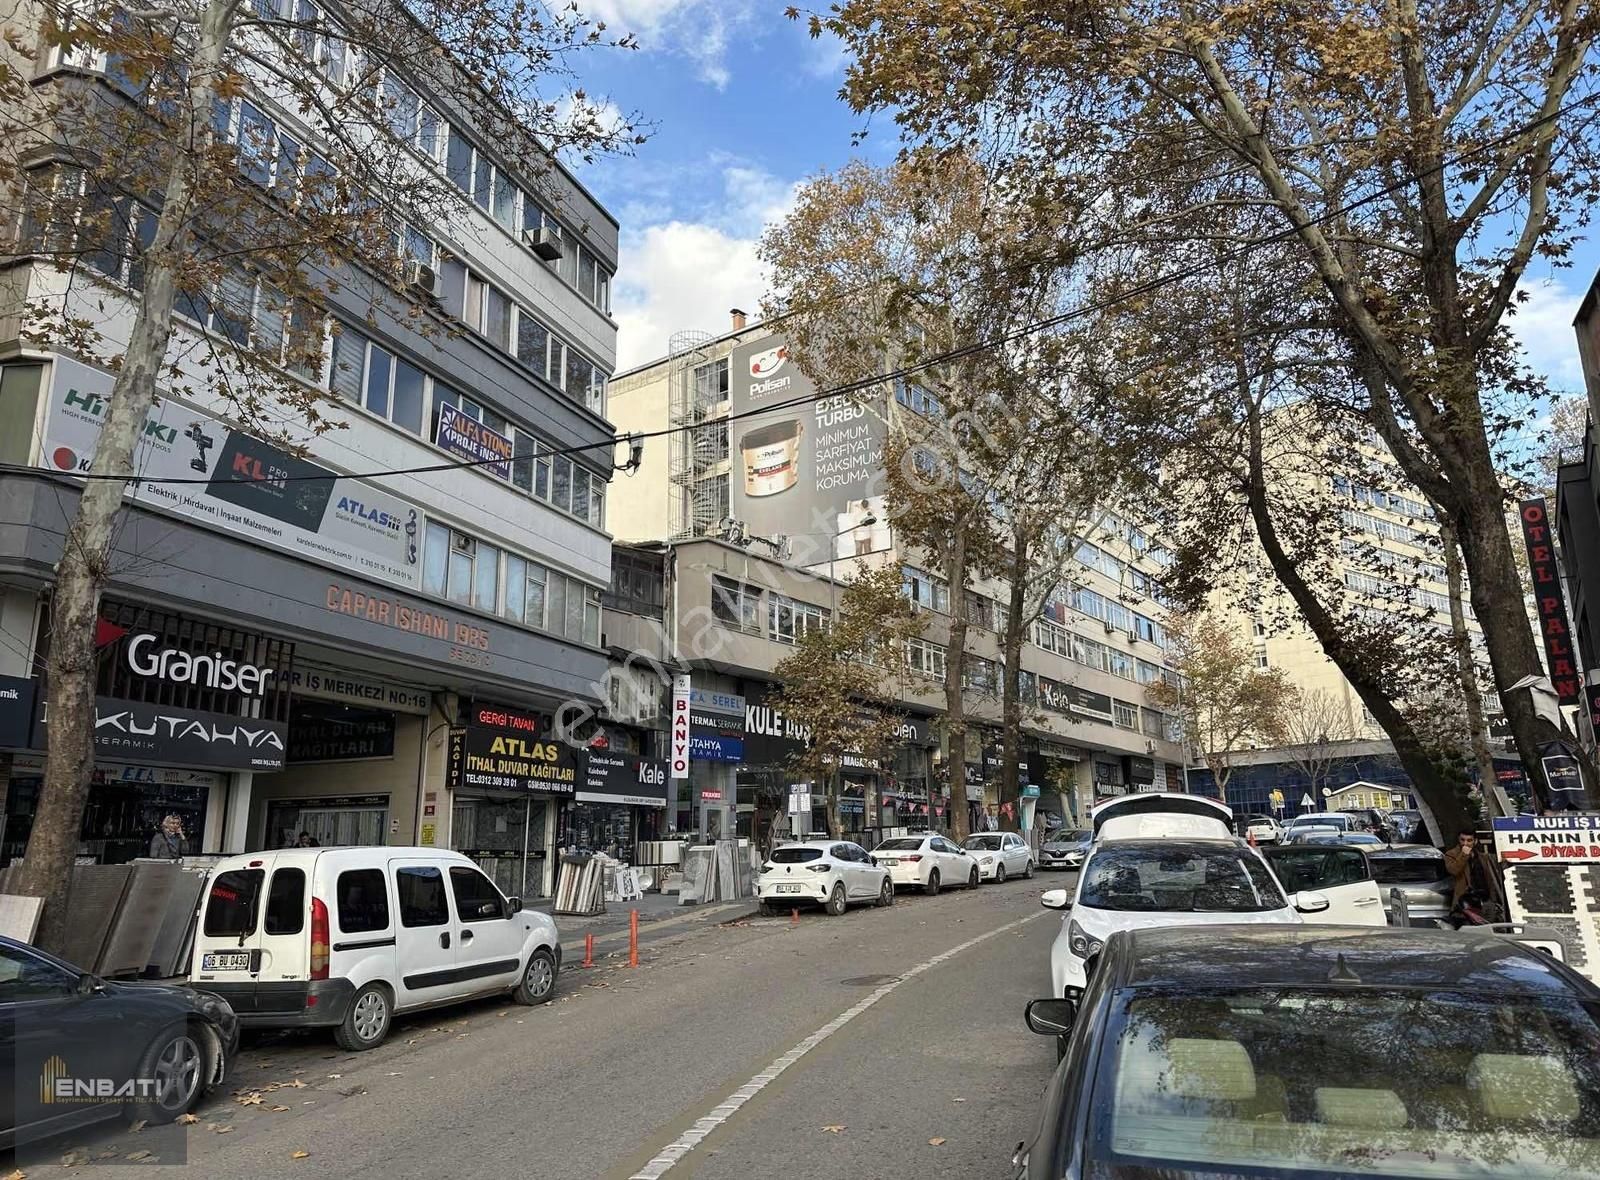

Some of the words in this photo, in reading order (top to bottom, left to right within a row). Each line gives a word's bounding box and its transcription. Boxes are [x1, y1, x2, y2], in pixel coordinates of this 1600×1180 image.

[750, 376, 791, 396] Polisan
[816, 402, 865, 428] TURBO
[450, 431, 478, 454] PROJE
[452, 415, 480, 442] ALFA
[481, 429, 512, 458] STONE
[815, 423, 869, 450] MİNİMUM
[815, 437, 872, 463] SARFİYAT
[233, 451, 266, 482] KL
[816, 450, 882, 478] MAKSİMUM
[816, 470, 870, 491] KORUMA
[147, 484, 178, 502] Elektrik
[243, 517, 282, 538] Malzemeleri
[337, 496, 390, 527] ATLAS
[1523, 505, 1553, 583] OTEL
[1542, 596, 1577, 698] PALAN
[455, 622, 490, 651] 1985
[128, 633, 274, 696] Graniser
[306, 671, 321, 692] İŞ
[324, 678, 385, 701] MERKEZİ
[389, 690, 427, 708] NO:16
[712, 694, 741, 709] SEREL
[95, 706, 284, 751] KÜTAHYA
[479, 710, 508, 727] GERGİ
[509, 716, 536, 732] TAVAN
[690, 715, 718, 728] TERMAL
[745, 703, 783, 738] KULE
[674, 699, 688, 772] BANYO
[490, 736, 559, 762] ATLAS
[466, 752, 496, 773] İTHAL
[498, 759, 529, 777] DUVAR
[530, 762, 575, 782] KAĞITLARI
[639, 761, 665, 785] Kale
[1533, 816, 1570, 829] NUH
[1508, 832, 1581, 844] HANIN
[1540, 843, 1588, 858] DİYAR
[207, 953, 216, 966] 06
